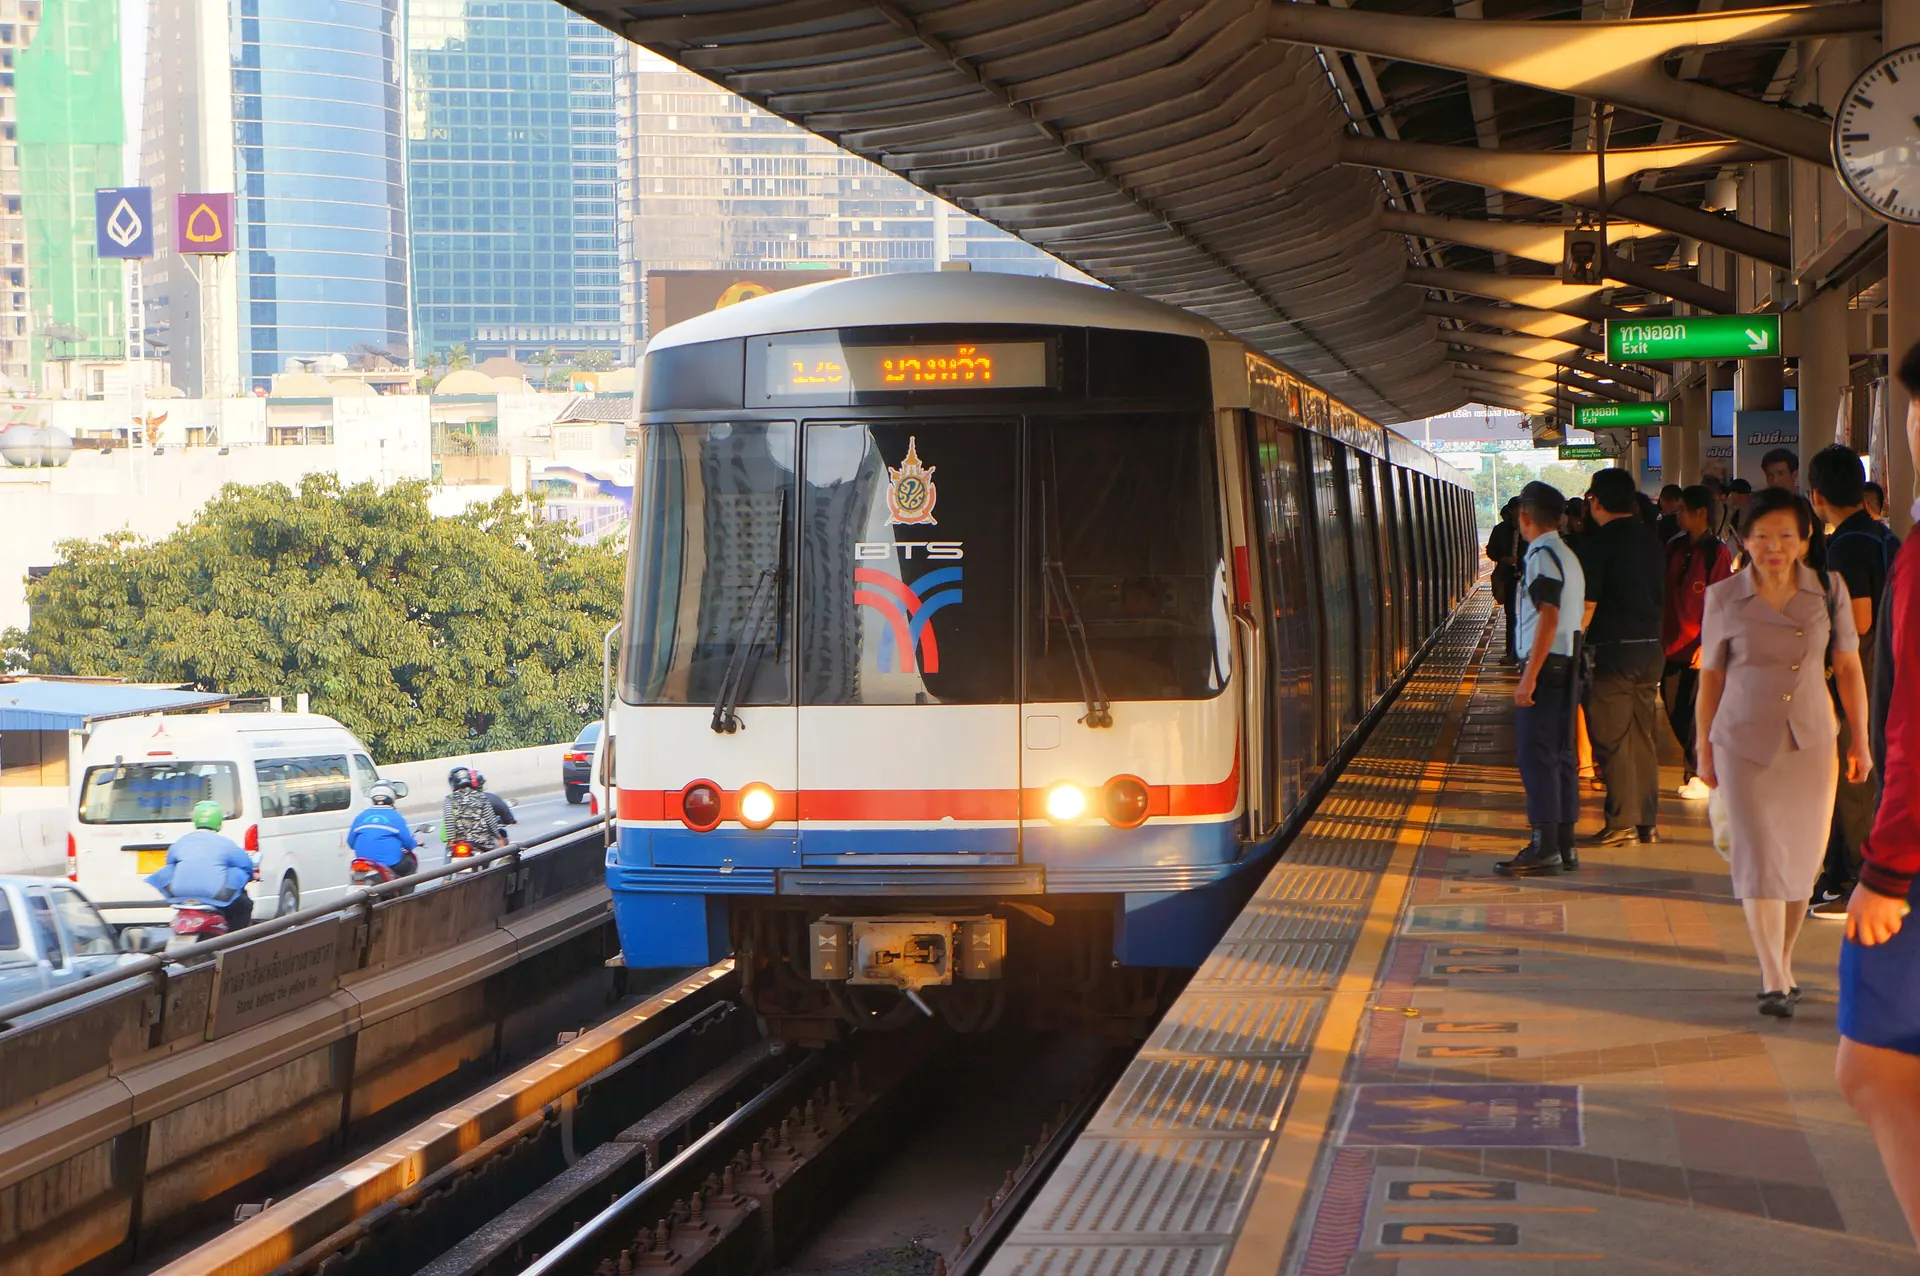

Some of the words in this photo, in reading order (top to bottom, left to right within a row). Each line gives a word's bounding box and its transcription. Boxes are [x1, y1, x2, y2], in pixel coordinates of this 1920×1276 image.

[1619, 324, 1686, 342] ทางออก
[1622, 342, 1648, 355] Exit
[1581, 407, 1619, 418] ทางออก
[1582, 417, 1598, 425] Exit
[854, 541, 964, 560] BTS
[236, 999, 254, 1015] Stand
[277, 987, 288, 1001] the
[288, 979, 307, 999] yellow
